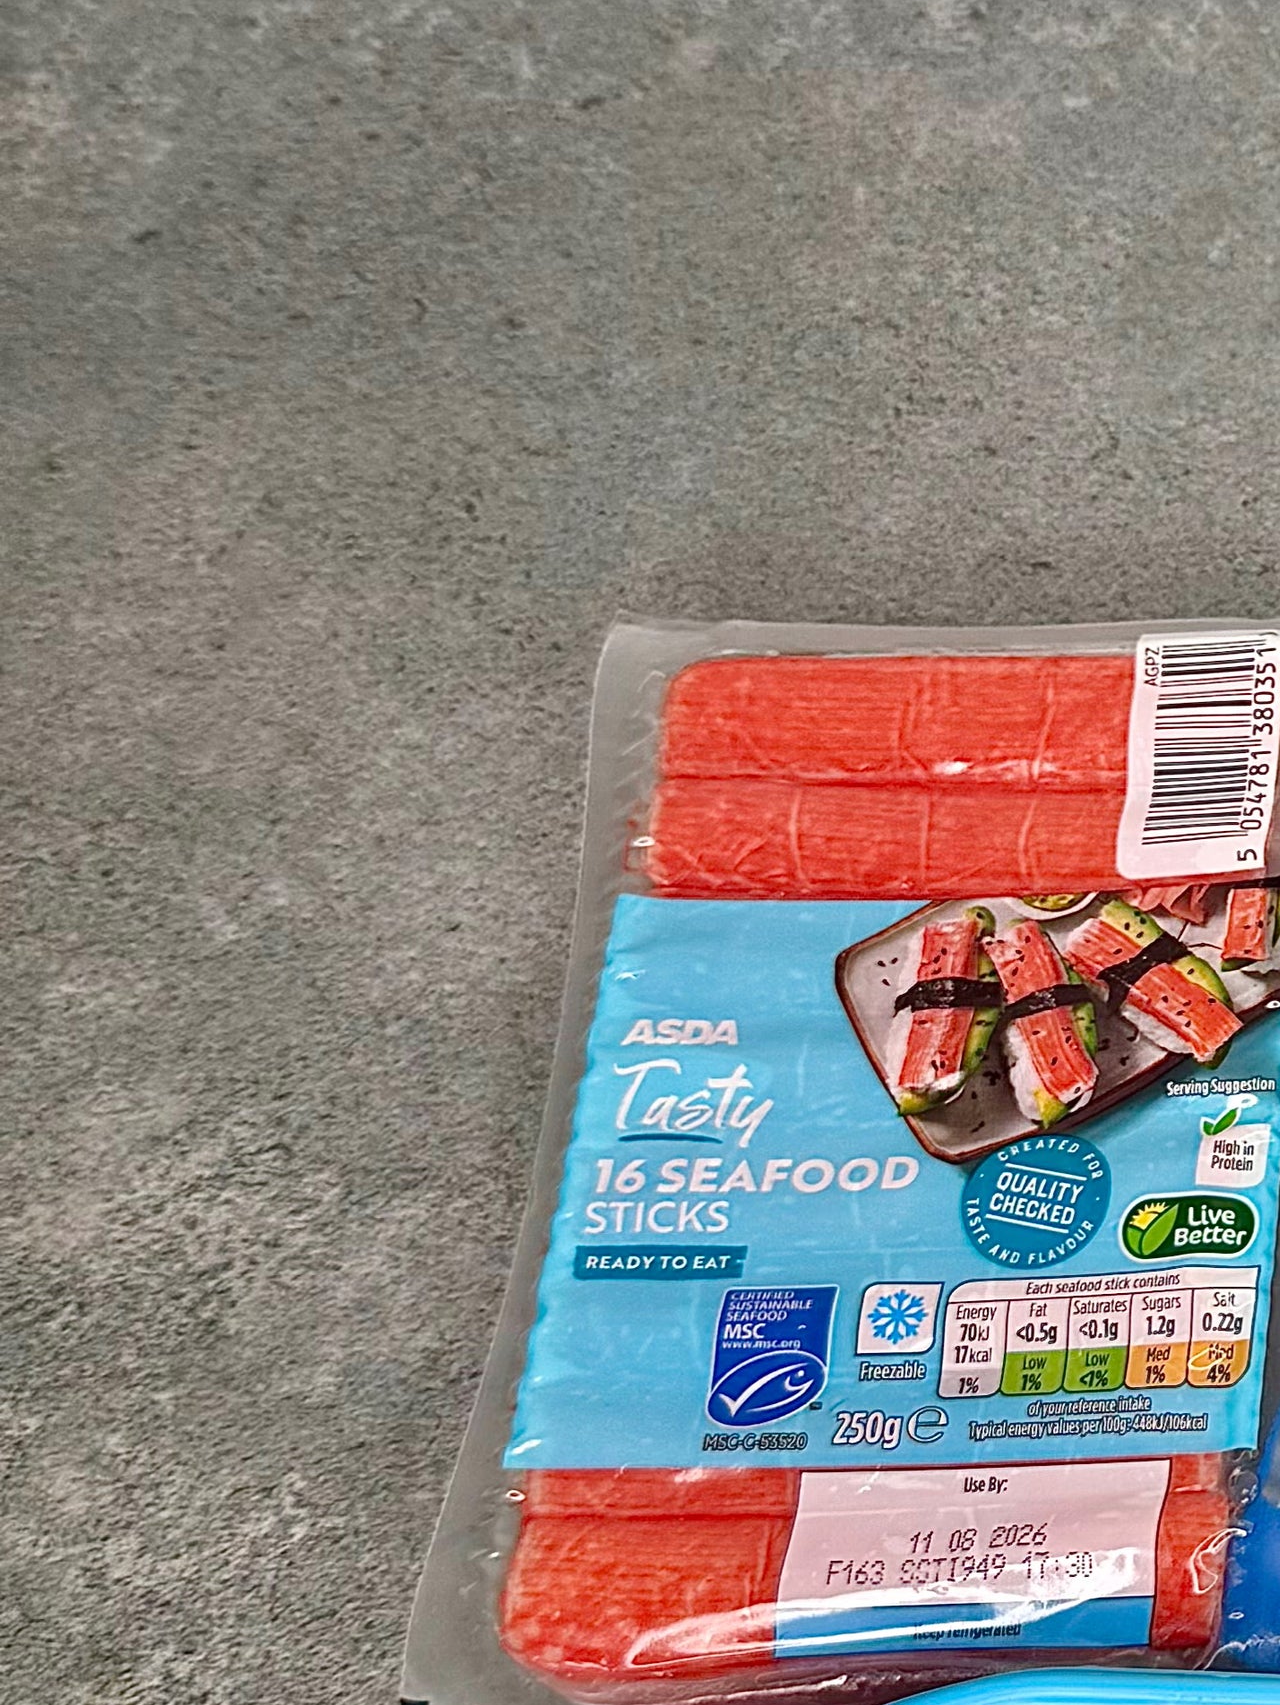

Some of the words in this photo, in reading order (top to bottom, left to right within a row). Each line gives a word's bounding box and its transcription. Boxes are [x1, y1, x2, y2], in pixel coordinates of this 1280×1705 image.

[1144, 647, 1160, 687] AGPZ
[1253, 647, 1277, 735] 380351
[1240, 750, 1271, 830] 054781
[1237, 849, 1257, 861] 5
[620, 1018, 739, 1046] ASDA
[1166, 1080, 1209, 1096] Serving
[1210, 1077, 1276, 1096] Suggestion
[613, 1058, 775, 1148] Tasty
[1213, 1140, 1240, 1157] High
[1243, 1141, 1254, 1155] in
[998, 1138, 1080, 1161] CREATED
[1083, 1151, 1104, 1180] FOR
[1211, 1156, 1253, 1171] Protein
[595, 1157, 646, 1193] 16
[656, 1156, 920, 1193] SEAFOOD
[997, 1172, 1084, 1204] QUALITY
[583, 1200, 730, 1235] STICKS
[989, 1193, 1076, 1225] CHECKED
[1188, 1205, 1235, 1226] Live
[966, 1197, 991, 1245] TASTE
[989, 1244, 1020, 1265] AND
[1028, 1219, 1094, 1265] FLAVOUR
[1174, 1227, 1246, 1247] Better
[585, 1255, 656, 1270] READY
[660, 1256, 688, 1270] TO
[692, 1255, 731, 1270] EAT
[1027, 1281, 1052, 1295] Each
[1055, 1278, 1102, 1293] seafood
[1105, 1276, 1130, 1291] stick
[1133, 1273, 1181, 1289] contains
[728, 1300, 813, 1311] SUSTAINABLE
[956, 1304, 996, 1321] Energy
[1029, 1303, 1047, 1317] Fat
[1073, 1300, 1127, 1315] Saturates
[1142, 1296, 1181, 1312] Sugars
[726, 1311, 787, 1321] SEAFOOD
[1202, 1313, 1243, 1335] 0.22g
[723, 1323, 766, 1340] MSC
[1016, 1325, 1058, 1344] <0.5g
[1079, 1320, 1119, 1340] <0.1g
[1146, 1316, 1175, 1337] 1.2g
[722, 1339, 801, 1351] www.msc.org
[1023, 1355, 1046, 1370] Low
[1086, 1352, 1109, 1367] Low
[1146, 1347, 1170, 1363] Med
[859, 1361, 927, 1380] Freezable
[1080, 1370, 1109, 1387] <1%
[1145, 1366, 1166, 1383] 1%
[958, 1378, 979, 1394] 1%
[1022, 1374, 1042, 1391] 1%
[1028, 1401, 1042, 1416] of
[1043, 1403, 1066, 1416] your
[1067, 1398, 1117, 1414] reference
[1118, 1396, 1151, 1411] intake
[832, 1411, 902, 1448] 250g
[969, 1422, 1006, 1441] Typical
[703, 1433, 809, 1451] MSC-C-53520
[964, 1477, 987, 1493] Use
[988, 1477, 1009, 1495] By:
[910, 1531, 934, 1553] 11
[949, 1528, 978, 1552] 08
[989, 1523, 1048, 1549] 2026
[826, 1559, 885, 1585] F163
[1020, 1550, 1093, 1580] 17:30
